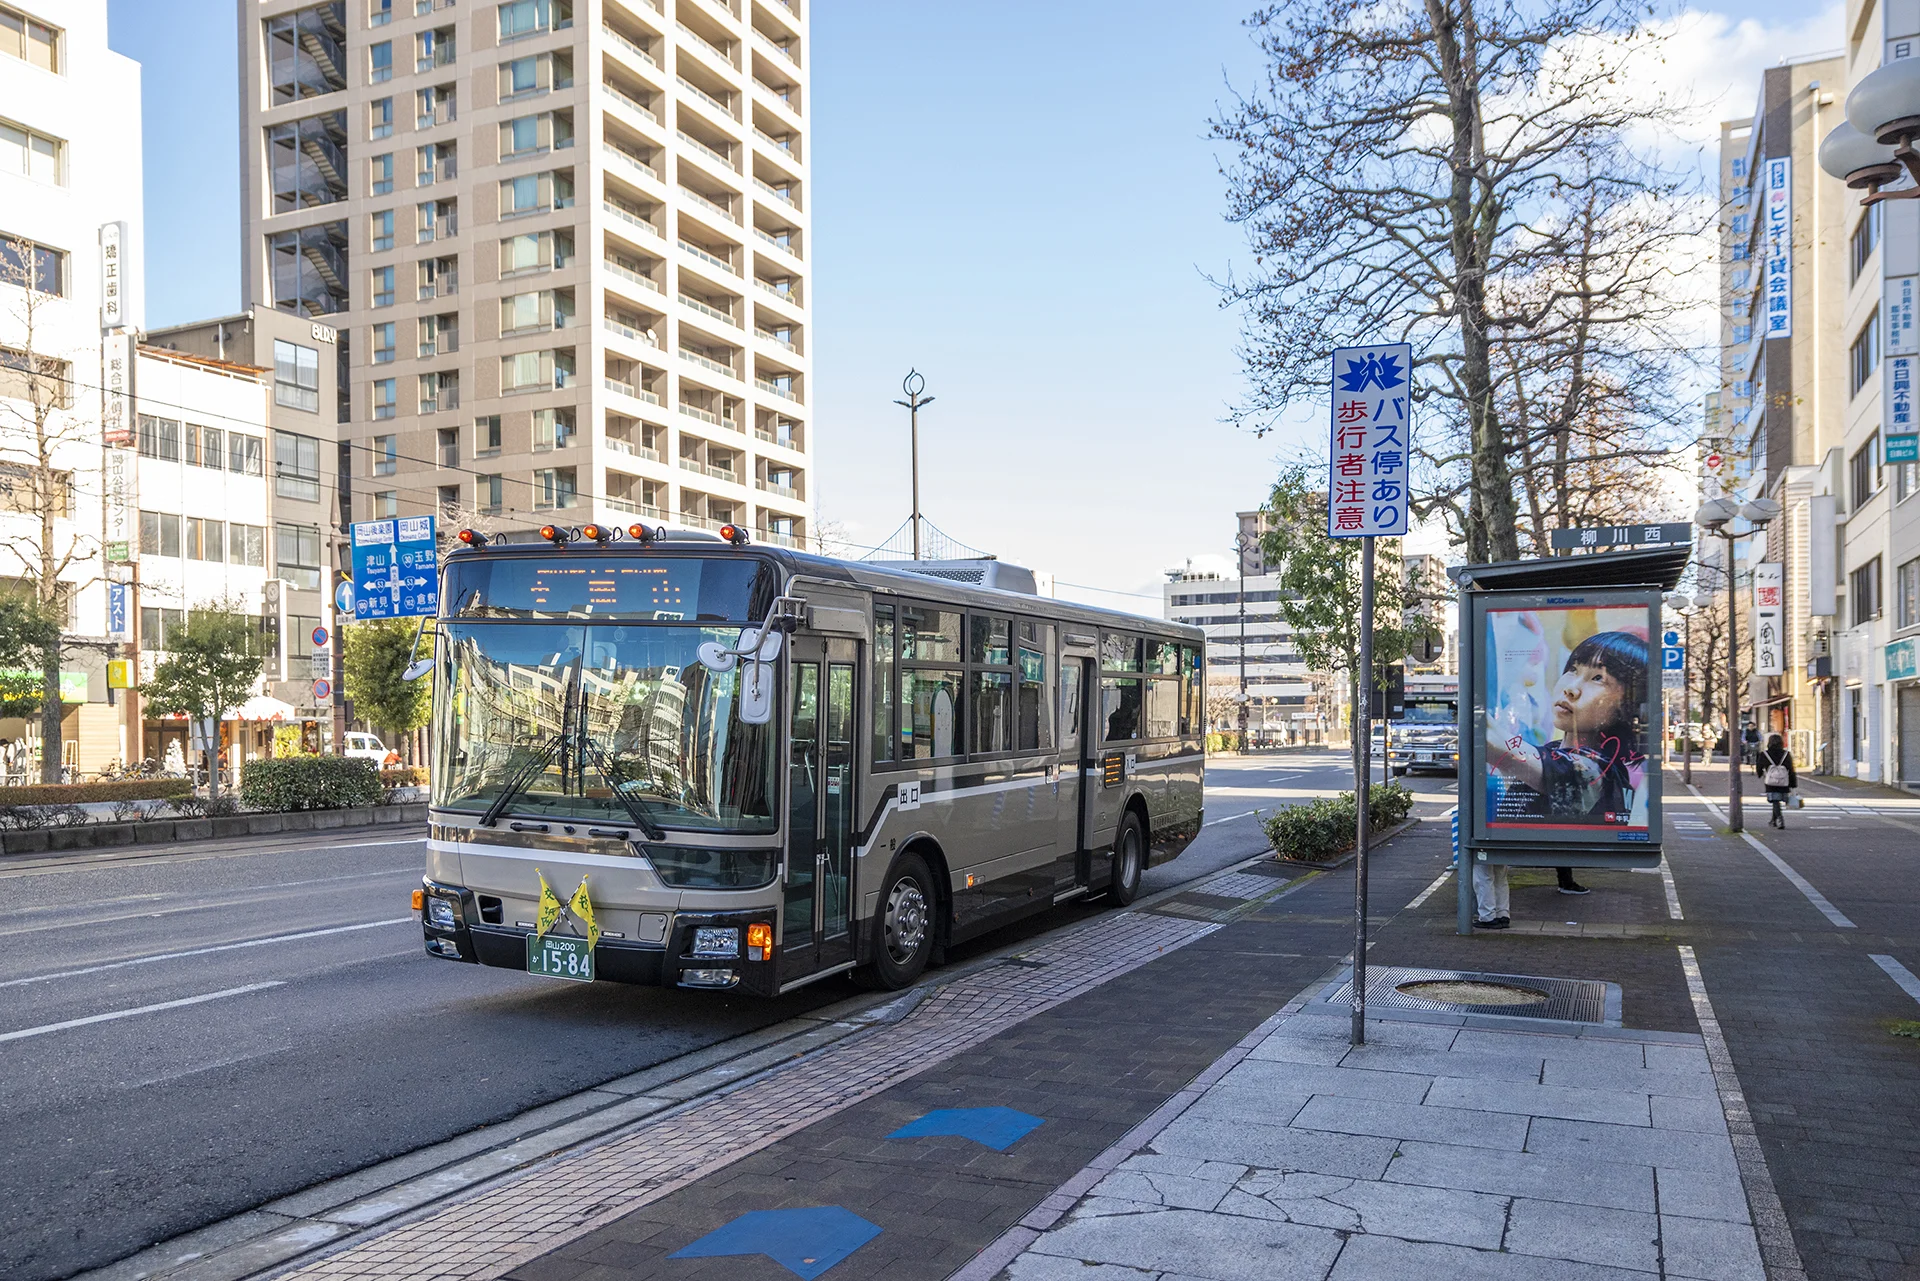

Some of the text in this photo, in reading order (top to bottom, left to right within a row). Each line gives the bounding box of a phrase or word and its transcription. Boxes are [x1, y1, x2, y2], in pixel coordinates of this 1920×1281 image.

[106, 244, 118, 315] 矯正歯科
[1335, 400, 1368, 530] 歩行者注意
[1371, 397, 1405, 529] バス停あり
[1580, 526, 1661, 545] 柳川西
[415, 550, 434, 563] 玉野
[369, 596, 388, 608] 新見
[417, 593, 436, 604] 倉敷
[113, 588, 123, 629] アスト
[1665, 650, 1680, 667] P
[900, 788, 918, 804] 出口
[543, 949, 590, 977] 15-84
